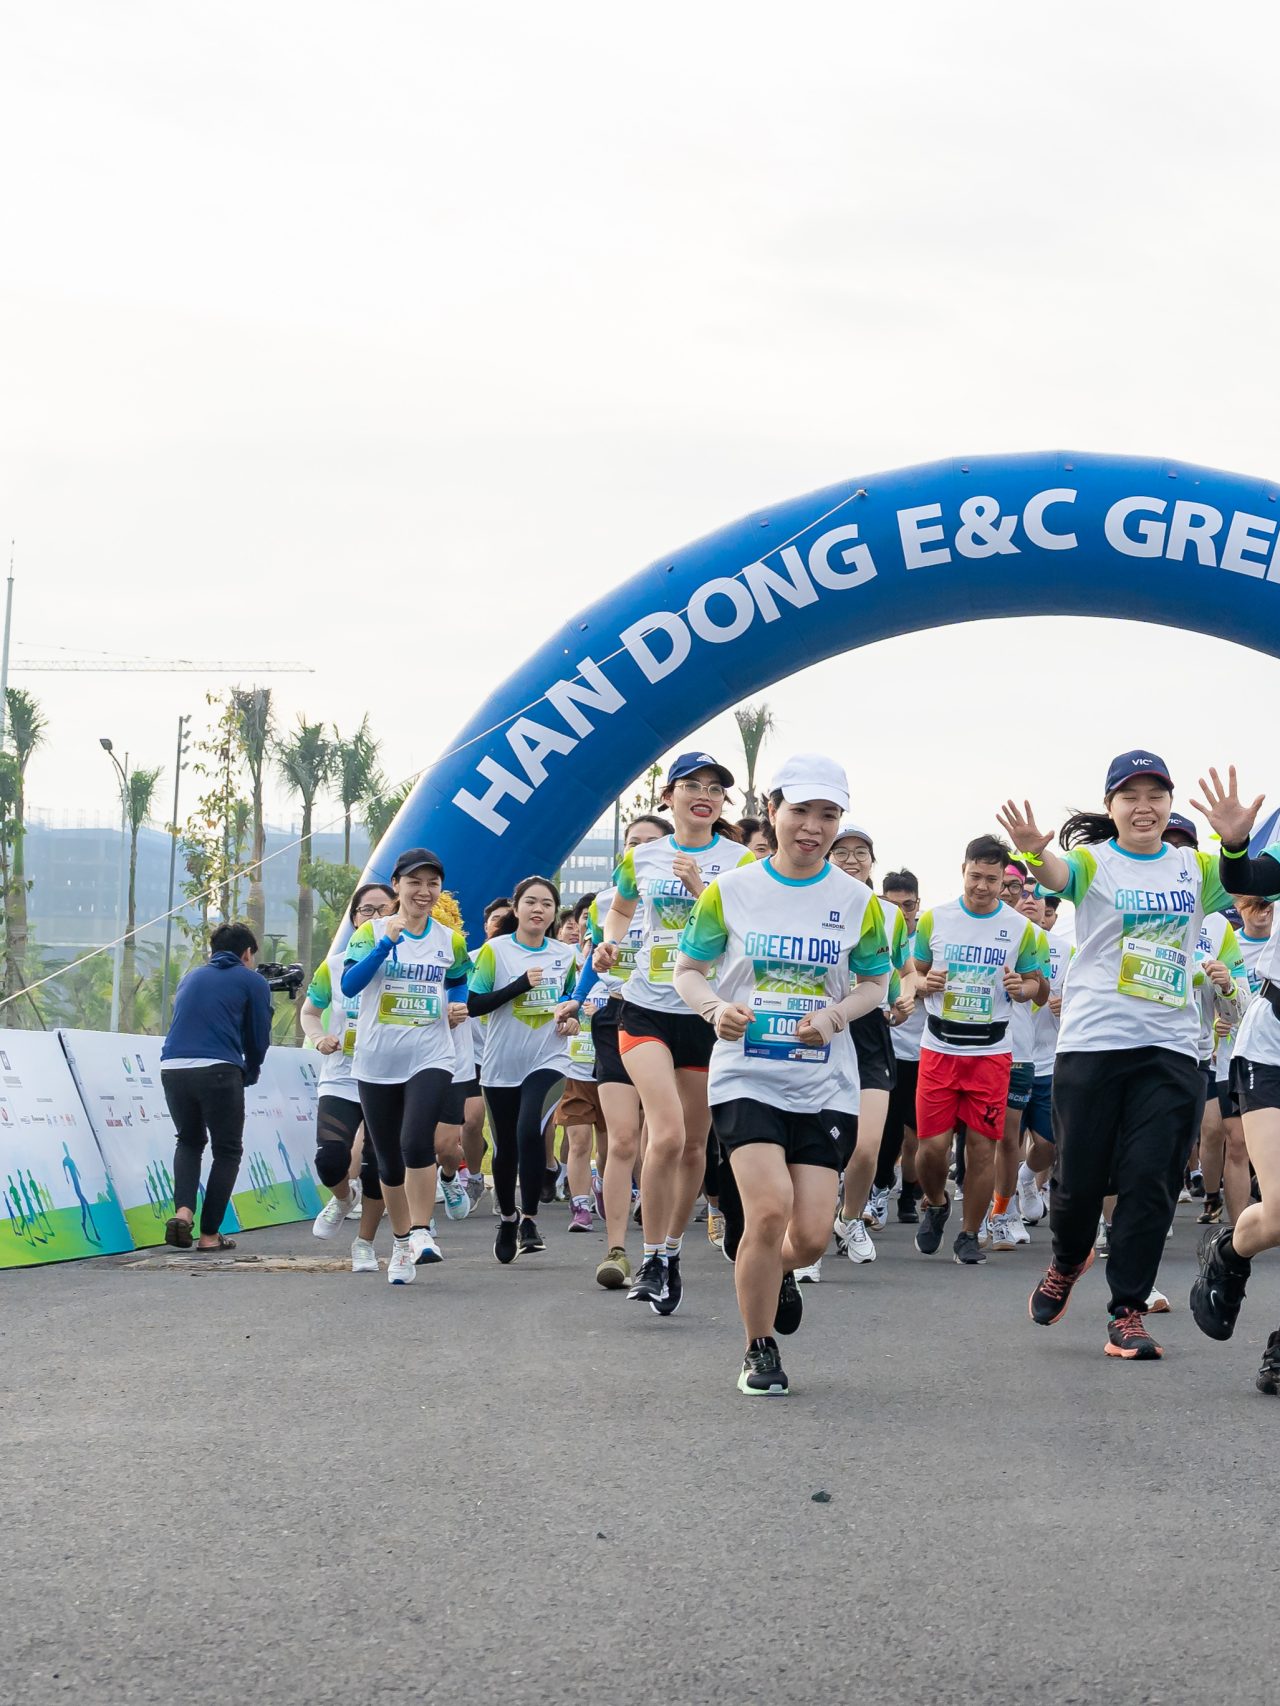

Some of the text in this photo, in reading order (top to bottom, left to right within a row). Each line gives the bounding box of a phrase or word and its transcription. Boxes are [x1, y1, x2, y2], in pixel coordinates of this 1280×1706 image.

[452, 657, 626, 836] HAN
[619, 524, 878, 684] DONG
[896, 488, 1078, 571] E&C
[1115, 888, 1195, 914] GREEN DAY
[745, 931, 841, 965] GREEN DAY
[944, 943, 1007, 966] GREEN DAY
[1140, 960, 1175, 984] 70175
[395, 997, 426, 1010] 70143
[526, 990, 551, 1001] 70141
[767, 1016, 801, 1035] 100
